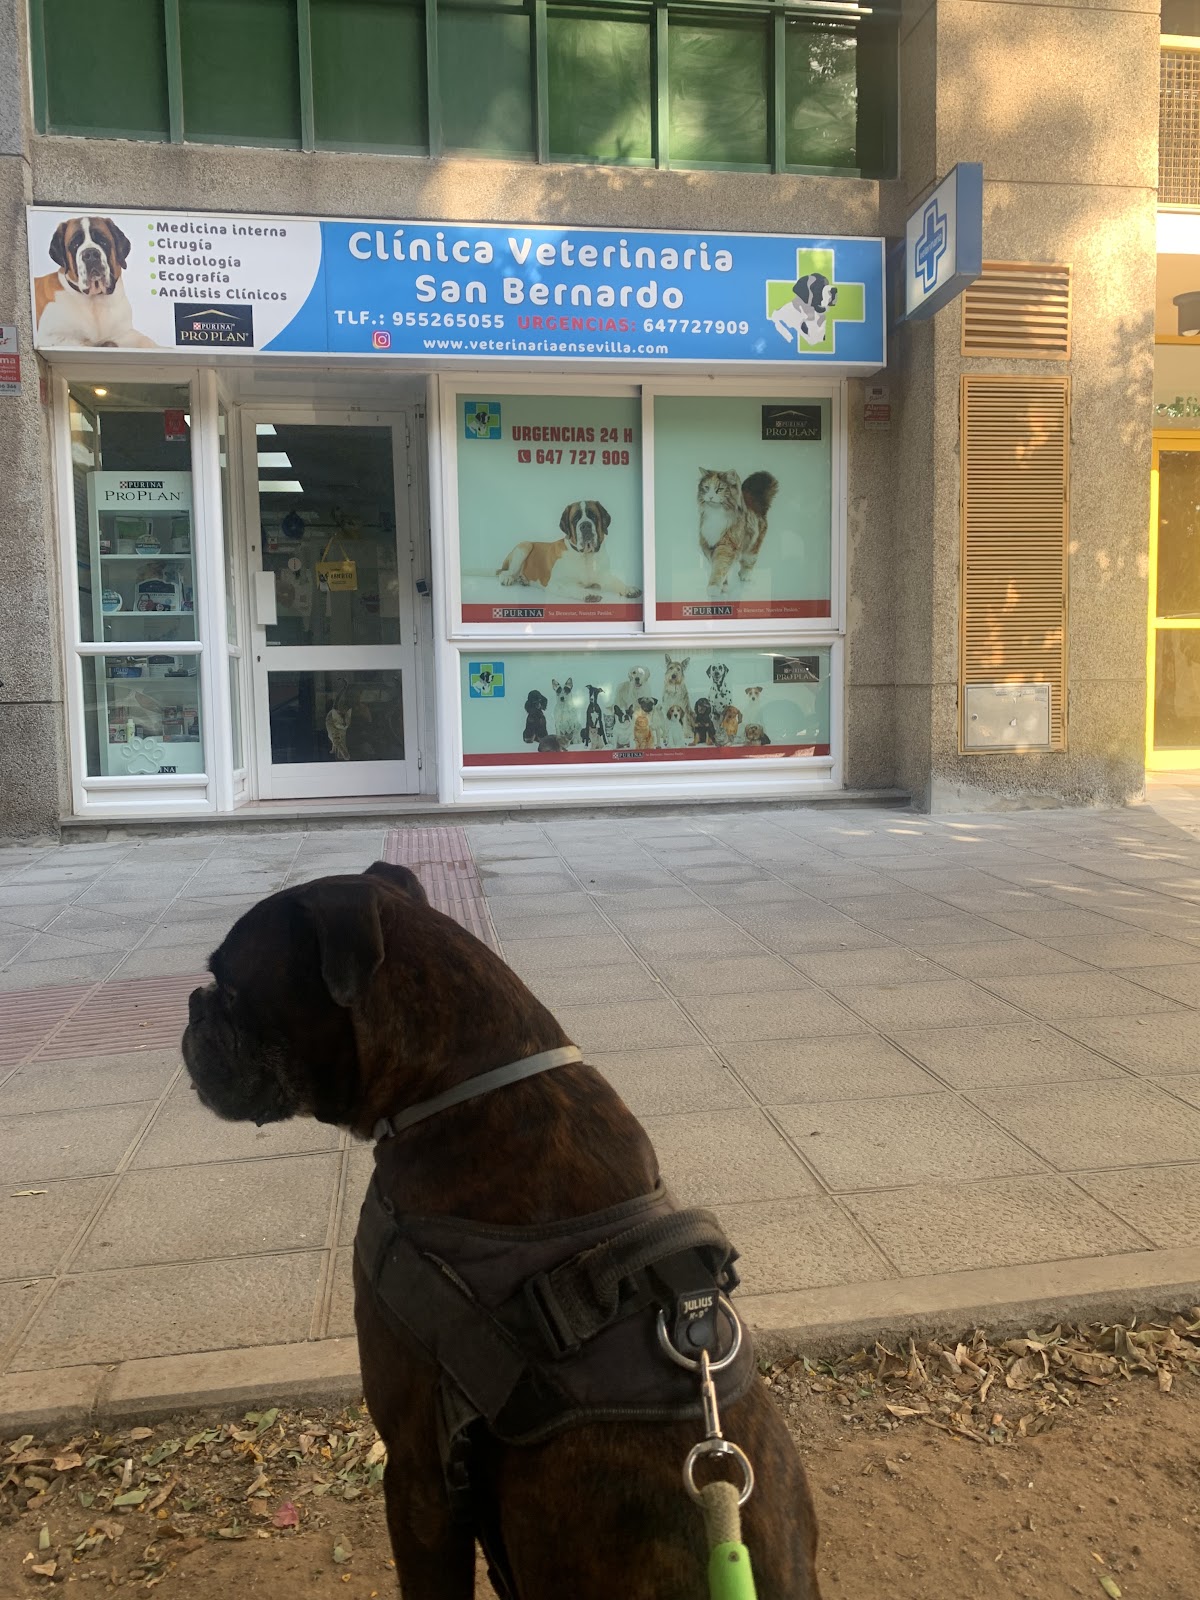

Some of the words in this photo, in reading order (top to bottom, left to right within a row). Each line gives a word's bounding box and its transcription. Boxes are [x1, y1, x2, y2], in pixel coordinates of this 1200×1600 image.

[156, 222, 227, 235] Medicina
[232, 224, 287, 237] interna
[156, 238, 212, 252] Cirugía
[348, 229, 494, 264] Clínica
[508, 237, 733, 272] Veterinaria
[158, 254, 241, 269] Radiología
[158, 270, 230, 284] Ecografía
[159, 286, 221, 299] Análisis
[226, 288, 287, 301] Clínicos
[415, 274, 487, 304] San
[503, 277, 684, 309] Bernardo
[334, 310, 385, 325] TLF.:
[392, 312, 505, 329] 955265055
[517, 315, 636, 332] URGENCIAS:
[643, 318, 749, 335] 647727909
[423, 339, 669, 354] www.veterinariaensevilla.com
[512, 426, 595, 442] URGENCIAS
[600, 427, 618, 443] 24
[624, 428, 633, 443] H
[536, 449, 563, 465] 647
[571, 450, 596, 465] 727
[602, 451, 630, 465] 909
[128, 481, 163, 489] PURINA
[503, 609, 543, 617] PURINA
[693, 607, 731, 615] PURINA
[684, 1296, 713, 1315] JULIUS
